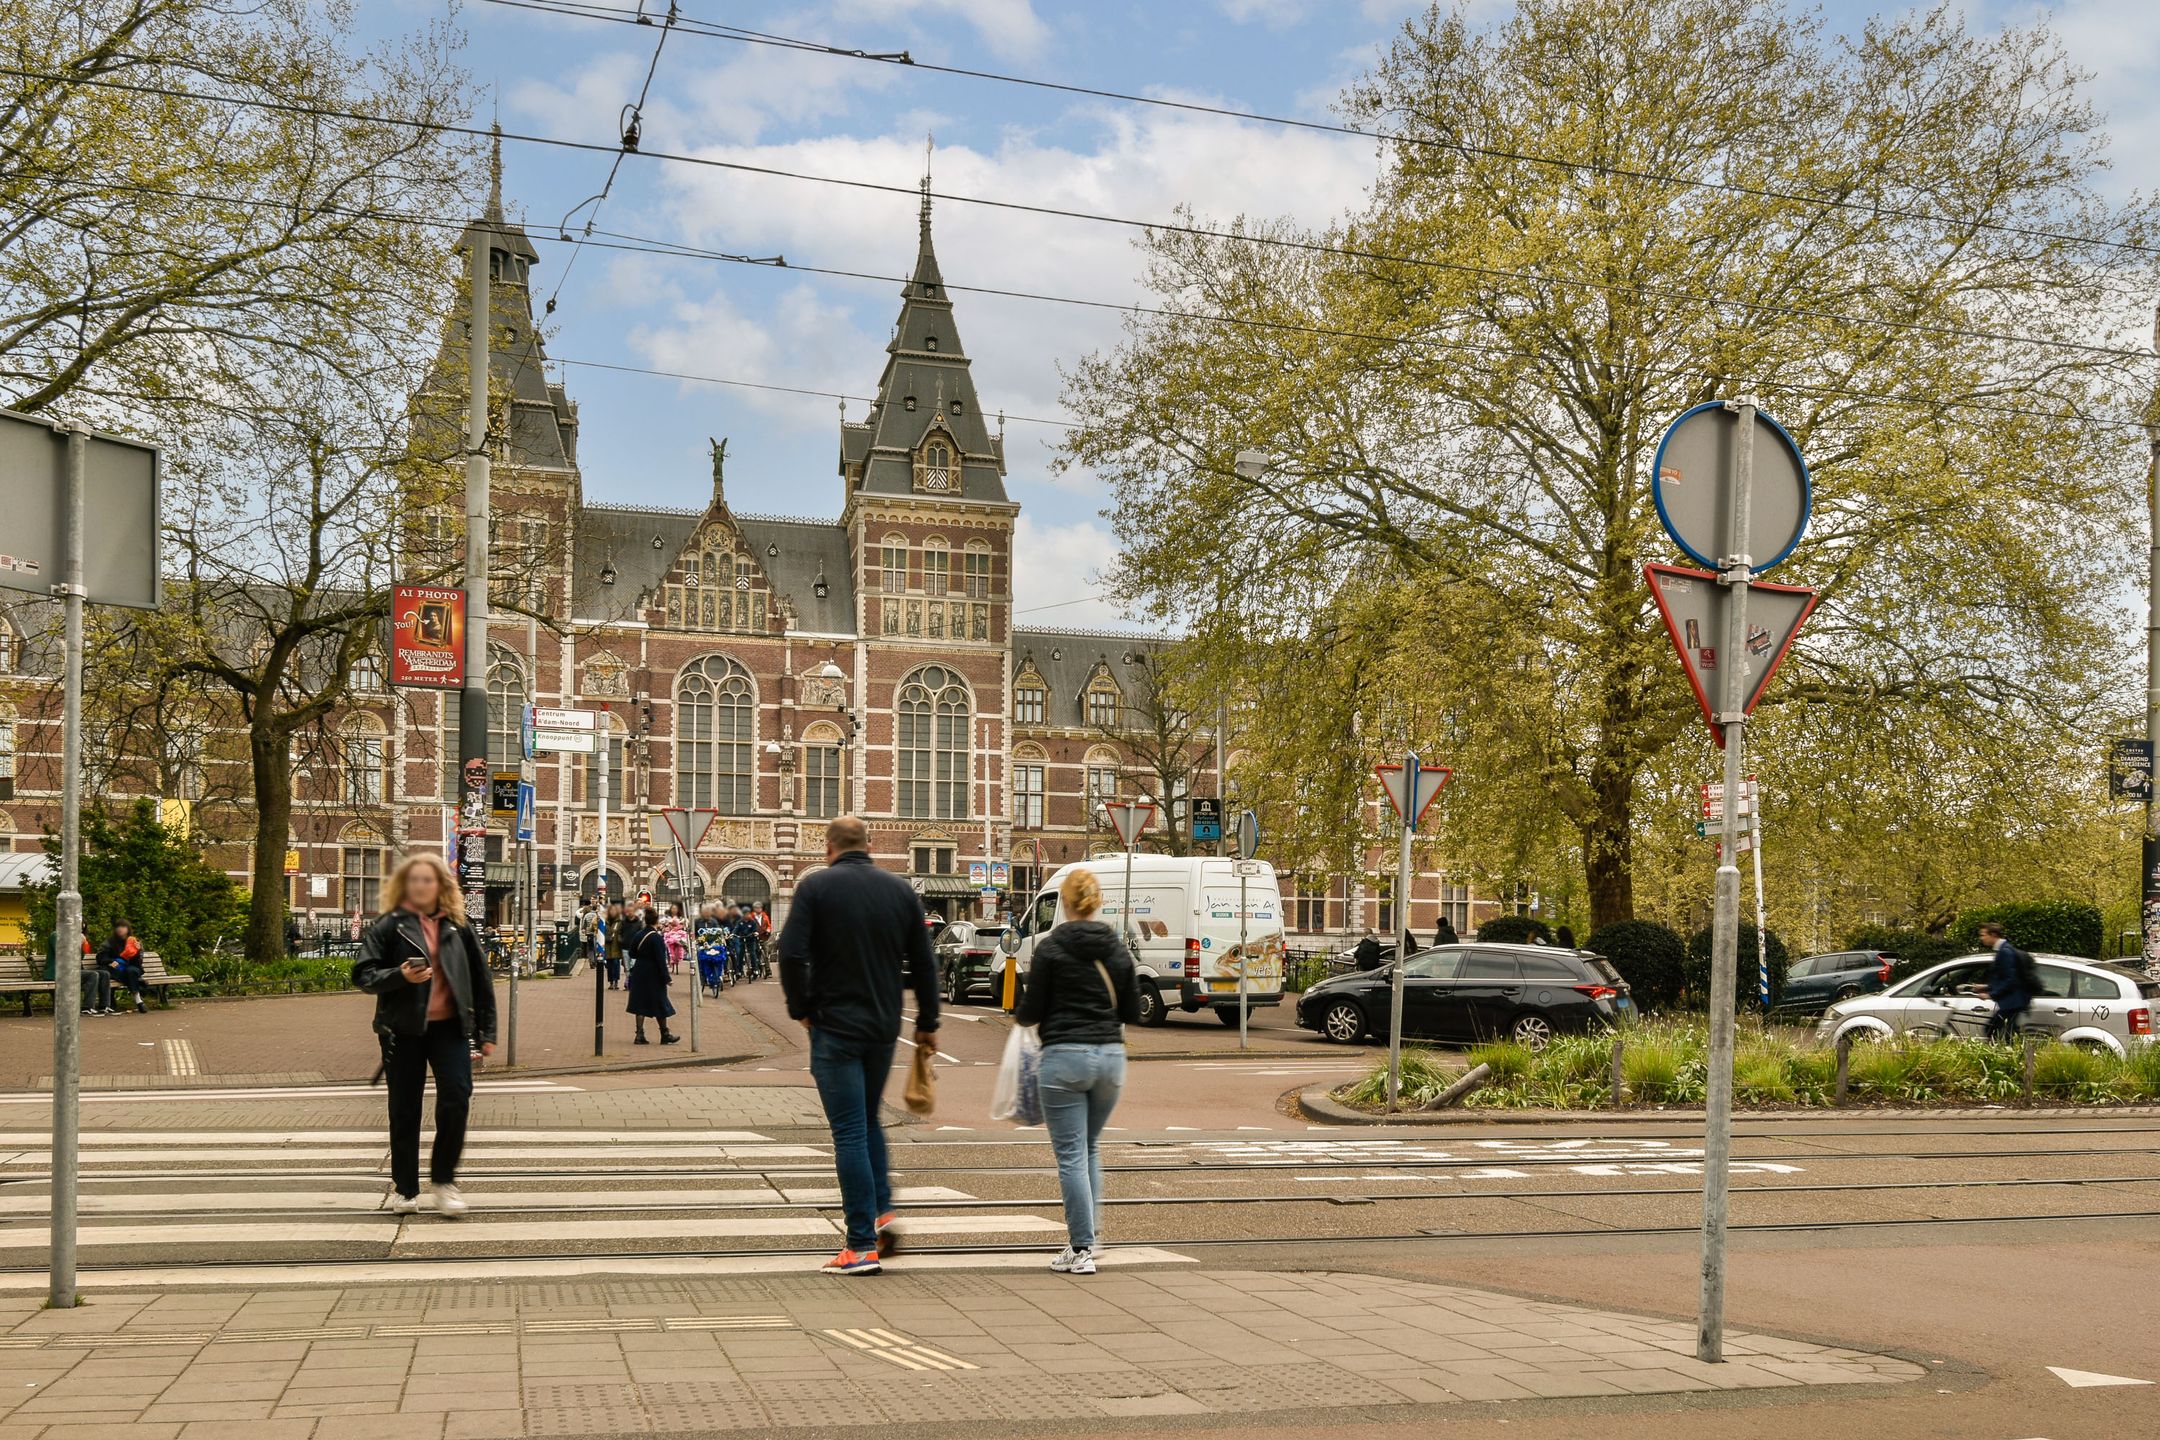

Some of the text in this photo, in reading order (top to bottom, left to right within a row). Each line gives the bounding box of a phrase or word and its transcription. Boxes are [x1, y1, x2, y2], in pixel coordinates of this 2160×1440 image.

[400, 589, 458, 600] AI PHOTO
[394, 620, 414, 630] YOU!
[405, 656, 457, 668] AMSTERDAM
[538, 719, 580, 727] A'dam-Noord
[1205, 895, 1231, 913] Jan
[1254, 965, 1273, 976] vers
